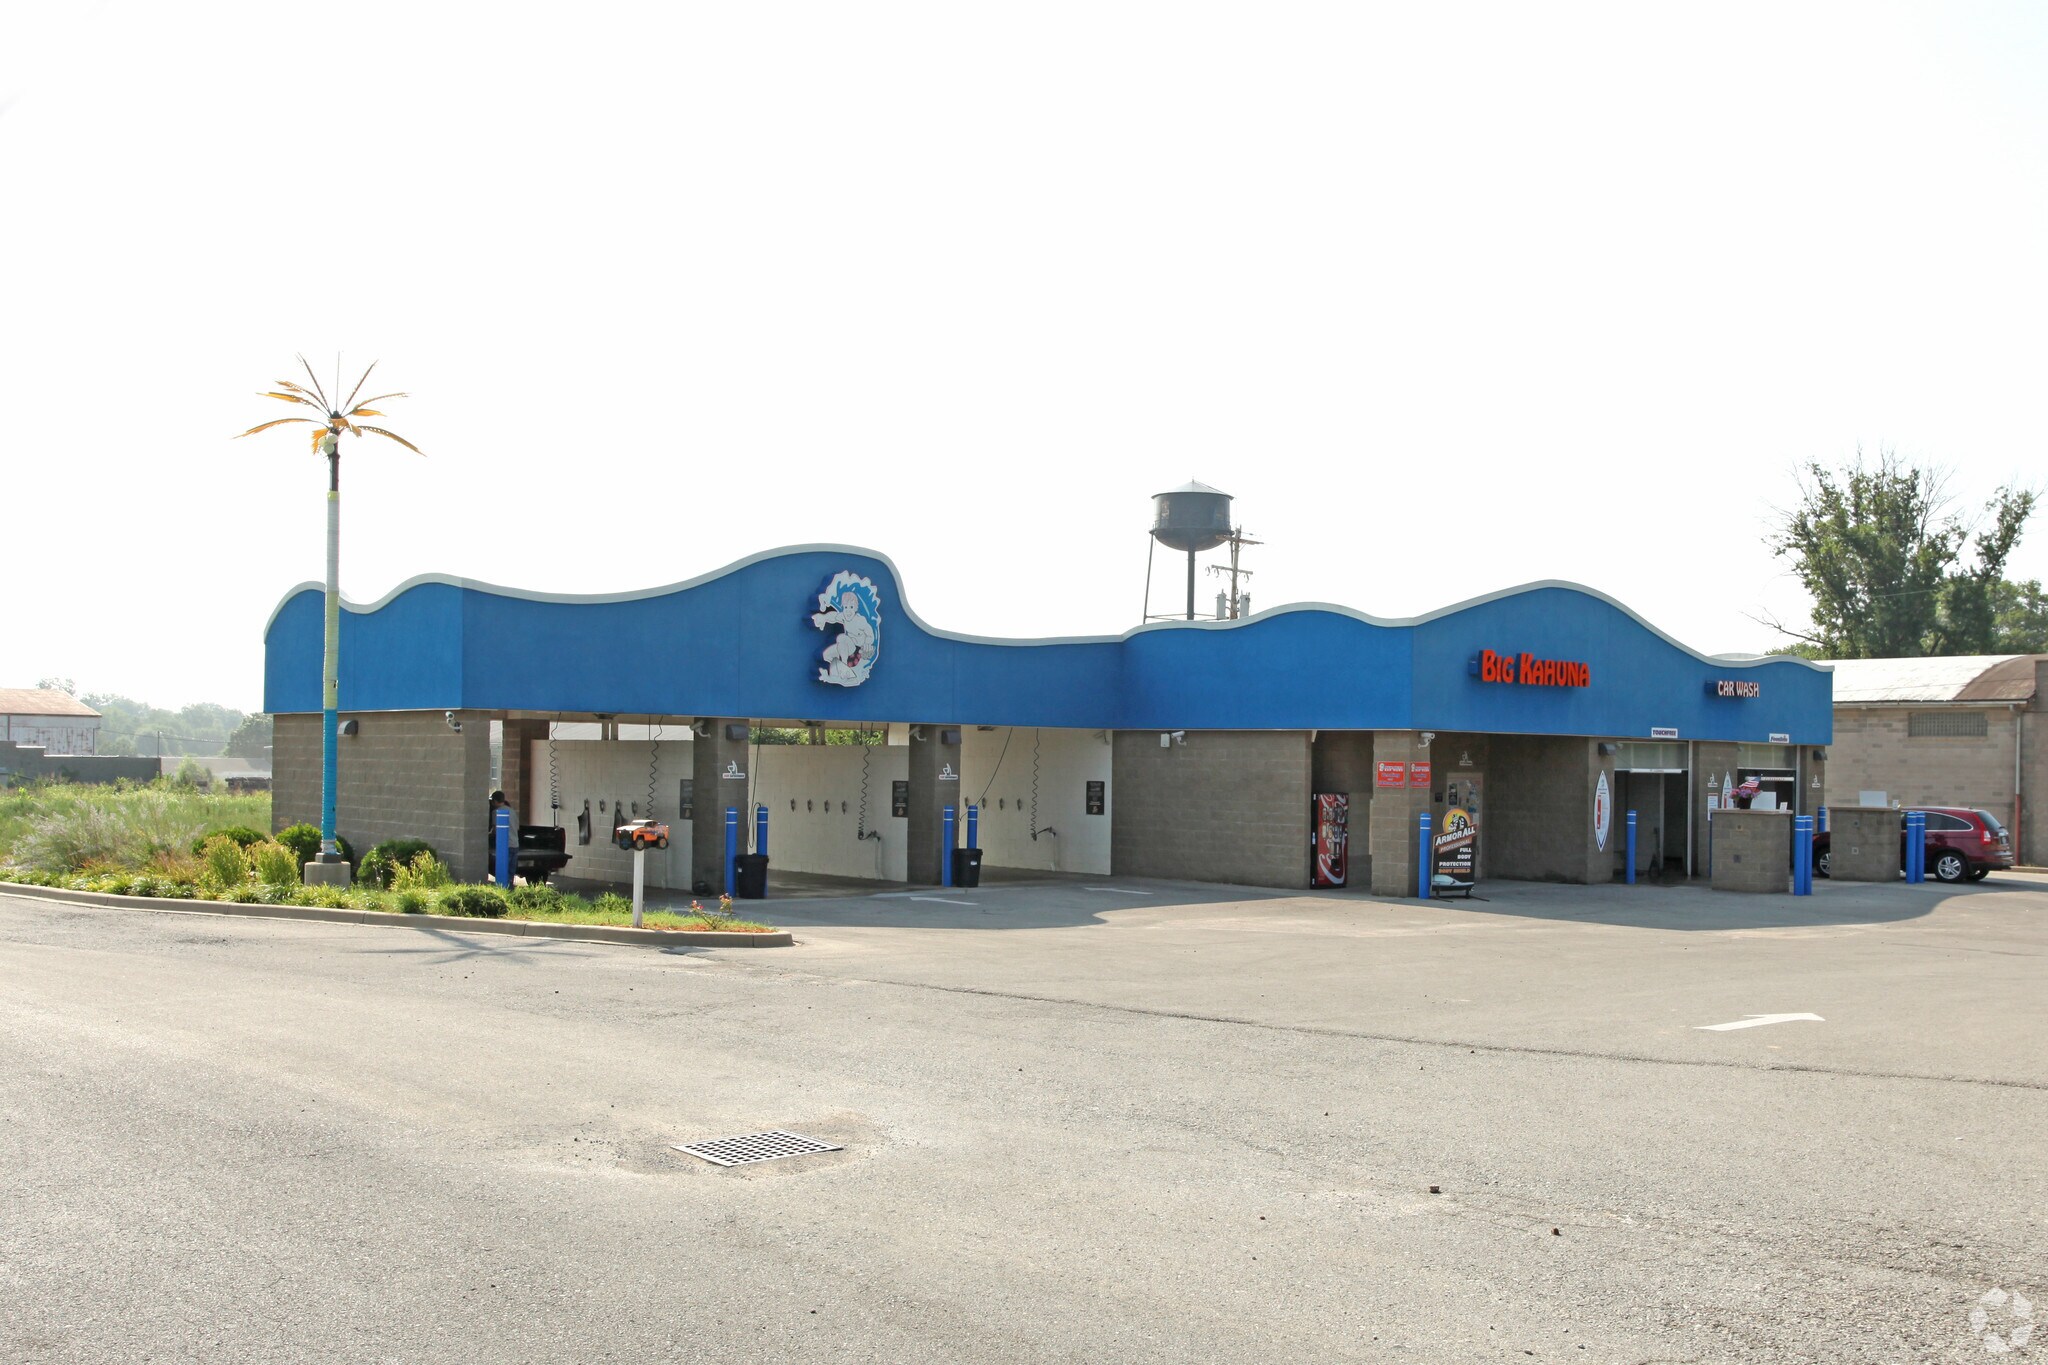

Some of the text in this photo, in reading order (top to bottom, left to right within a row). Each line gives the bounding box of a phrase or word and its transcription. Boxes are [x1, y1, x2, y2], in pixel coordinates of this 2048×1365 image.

[1482, 649, 1590, 688] BIG KAHUNA
[1717, 680, 1760, 698] CAR WASH
[1436, 826, 1476, 846] ARMOR ALL
